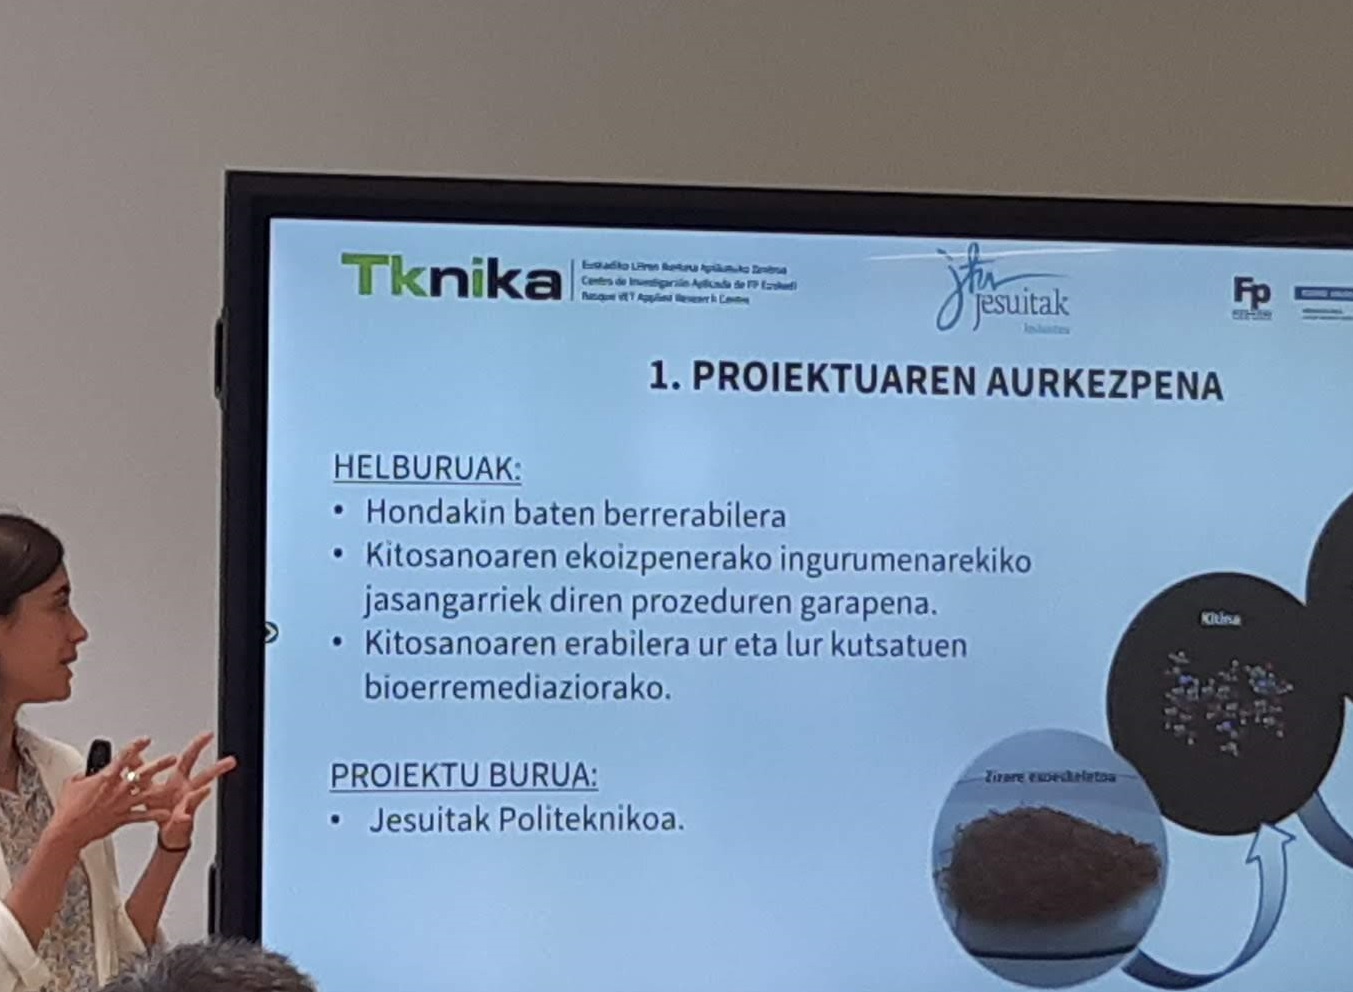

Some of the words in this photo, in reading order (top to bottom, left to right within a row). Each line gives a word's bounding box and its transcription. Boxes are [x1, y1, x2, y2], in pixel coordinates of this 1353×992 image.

[341, 252, 562, 301] Tknika
[649, 360, 681, 391] 1.
[692, 359, 976, 396] PROIEKTUAREN
[986, 365, 1225, 401] AURKEZPENA
[333, 453, 522, 482] HELBURUAK:
[366, 497, 505, 525] Hondakin
[514, 499, 595, 526] baten
[604, 499, 787, 528] berrerabilera
[366, 540, 557, 569] Kitosanoaren
[564, 542, 773, 576] ekoizpenerako
[780, 544, 1033, 579] ingurumenarekiko
[363, 584, 542, 619] jasangarriek
[549, 585, 623, 614] diren
[632, 586, 792, 620] prozeduren
[799, 593, 938, 622] garapena.
[365, 628, 557, 656] Kitosanoaren
[564, 629, 690, 657] erabilera
[699, 636, 727, 657] ur
[735, 633, 778, 658] eta
[786, 630, 823, 658] lur
[831, 630, 967, 659] kutsatuen
[364, 672, 672, 701] bioerremediaziorako.
[331, 762, 480, 790] PROIEKTU
[490, 761, 598, 790] BURUA:
[369, 804, 491, 833] Jesuitak
[500, 804, 685, 833] Politeknikoa.
